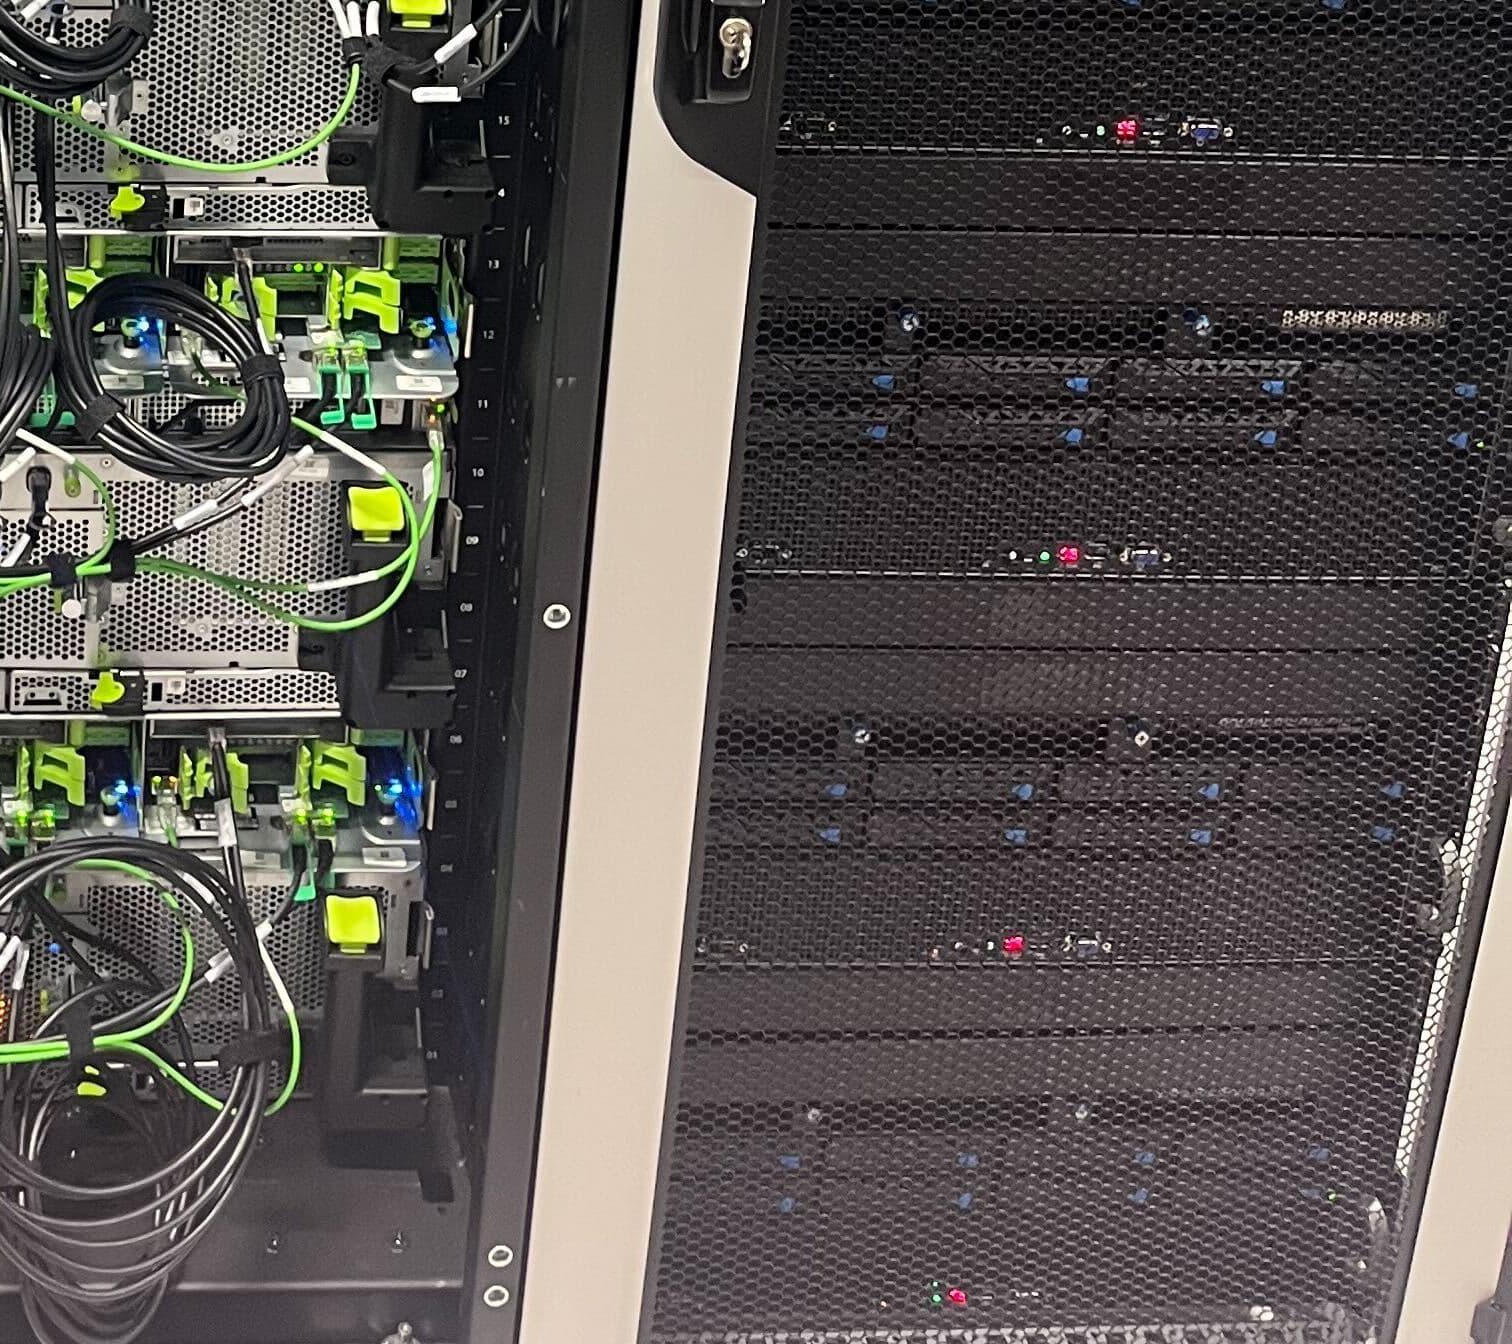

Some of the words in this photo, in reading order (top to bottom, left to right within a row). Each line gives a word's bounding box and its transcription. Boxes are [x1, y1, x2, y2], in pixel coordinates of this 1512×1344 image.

[498, 115, 510, 126] 15
[483, 329, 495, 340] 12
[477, 398, 488, 409] 11
[472, 467, 485, 478] 10
[454, 668, 467, 678] 07
